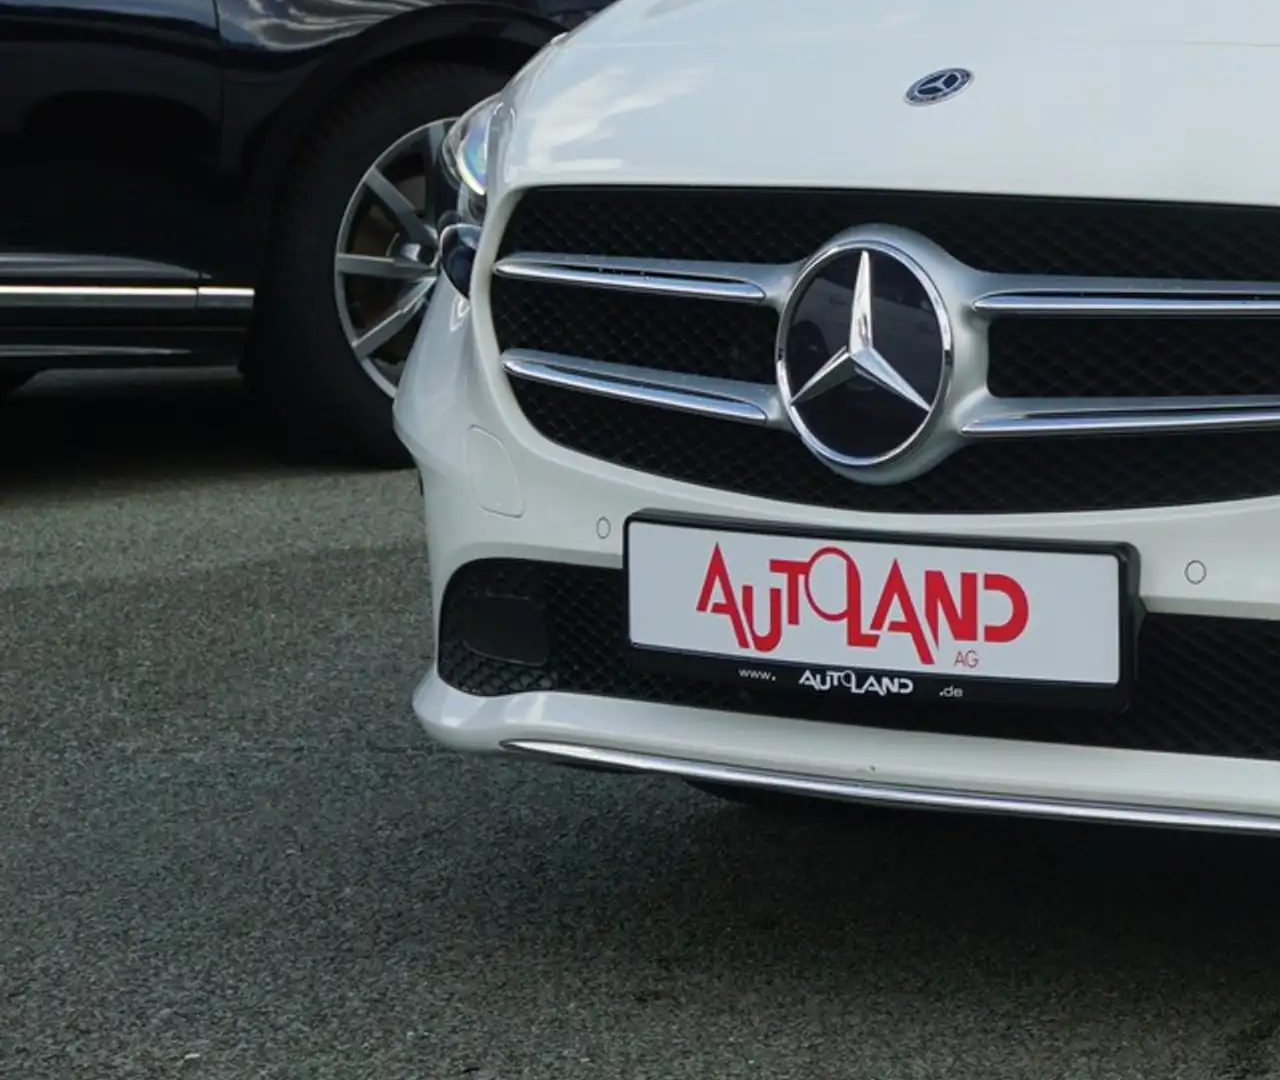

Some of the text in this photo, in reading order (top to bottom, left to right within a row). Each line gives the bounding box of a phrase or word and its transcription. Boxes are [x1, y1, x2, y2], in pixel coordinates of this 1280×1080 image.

[954, 649, 980, 669] AG
[738, 667, 777, 682] www.
[939, 684, 963, 697] .de
